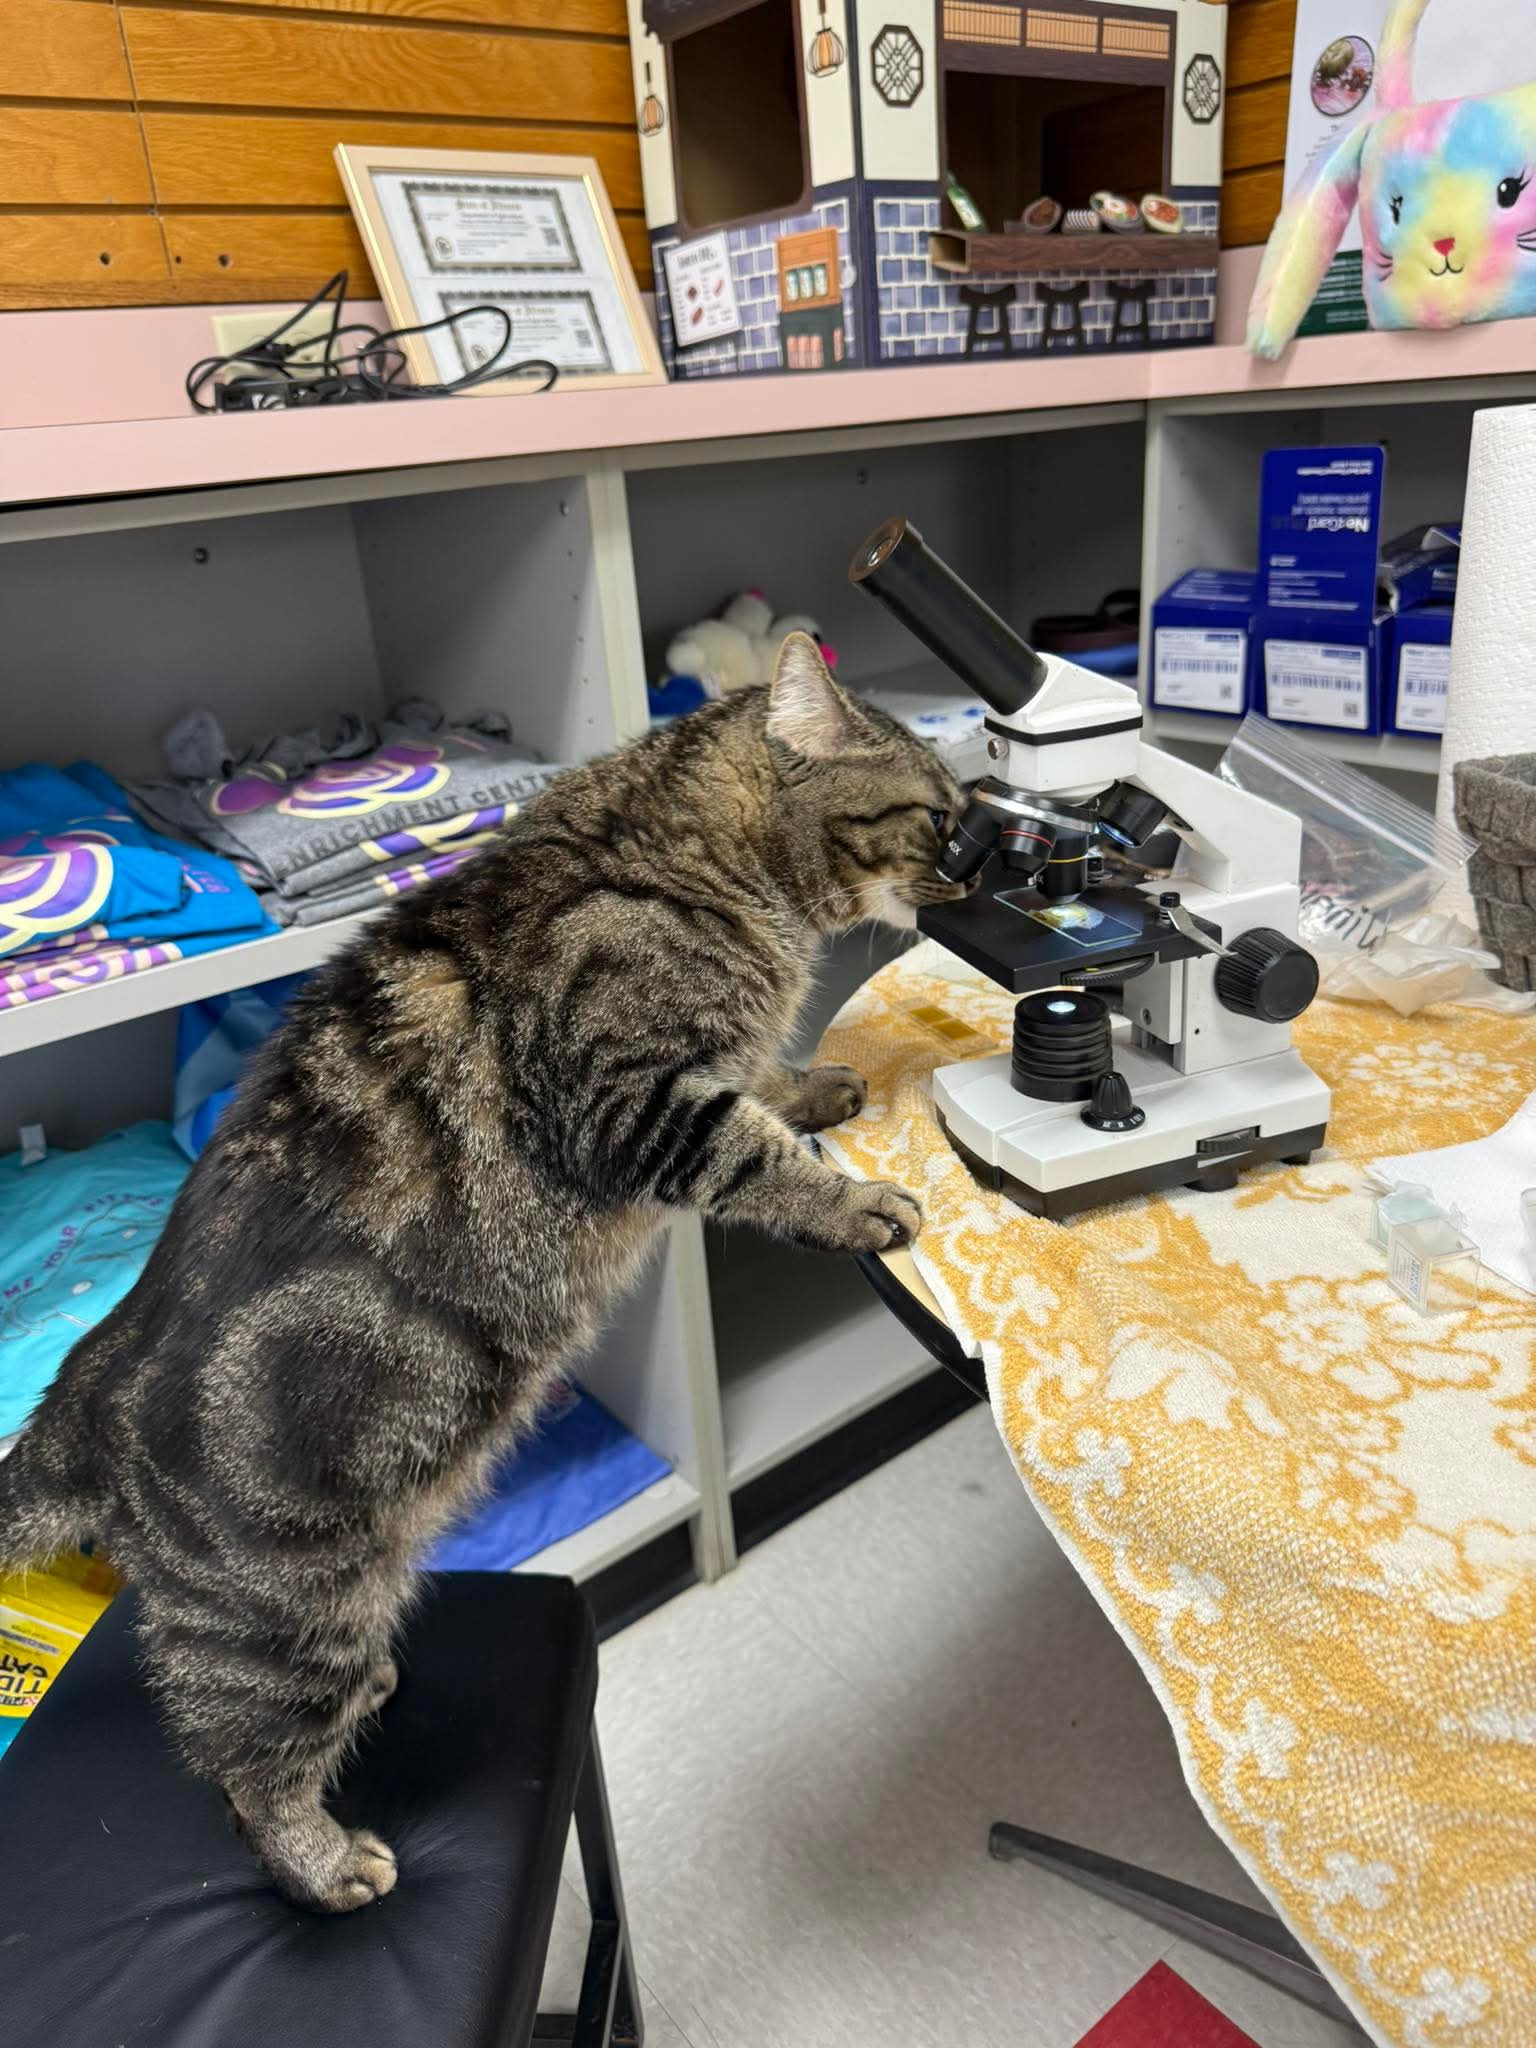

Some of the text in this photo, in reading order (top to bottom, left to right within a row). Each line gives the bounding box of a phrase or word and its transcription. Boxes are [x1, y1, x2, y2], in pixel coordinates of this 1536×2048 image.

[471, 771, 554, 807] CENT
[948, 840, 963, 856] 40X
[42, 1225, 78, 1270] YOUR
